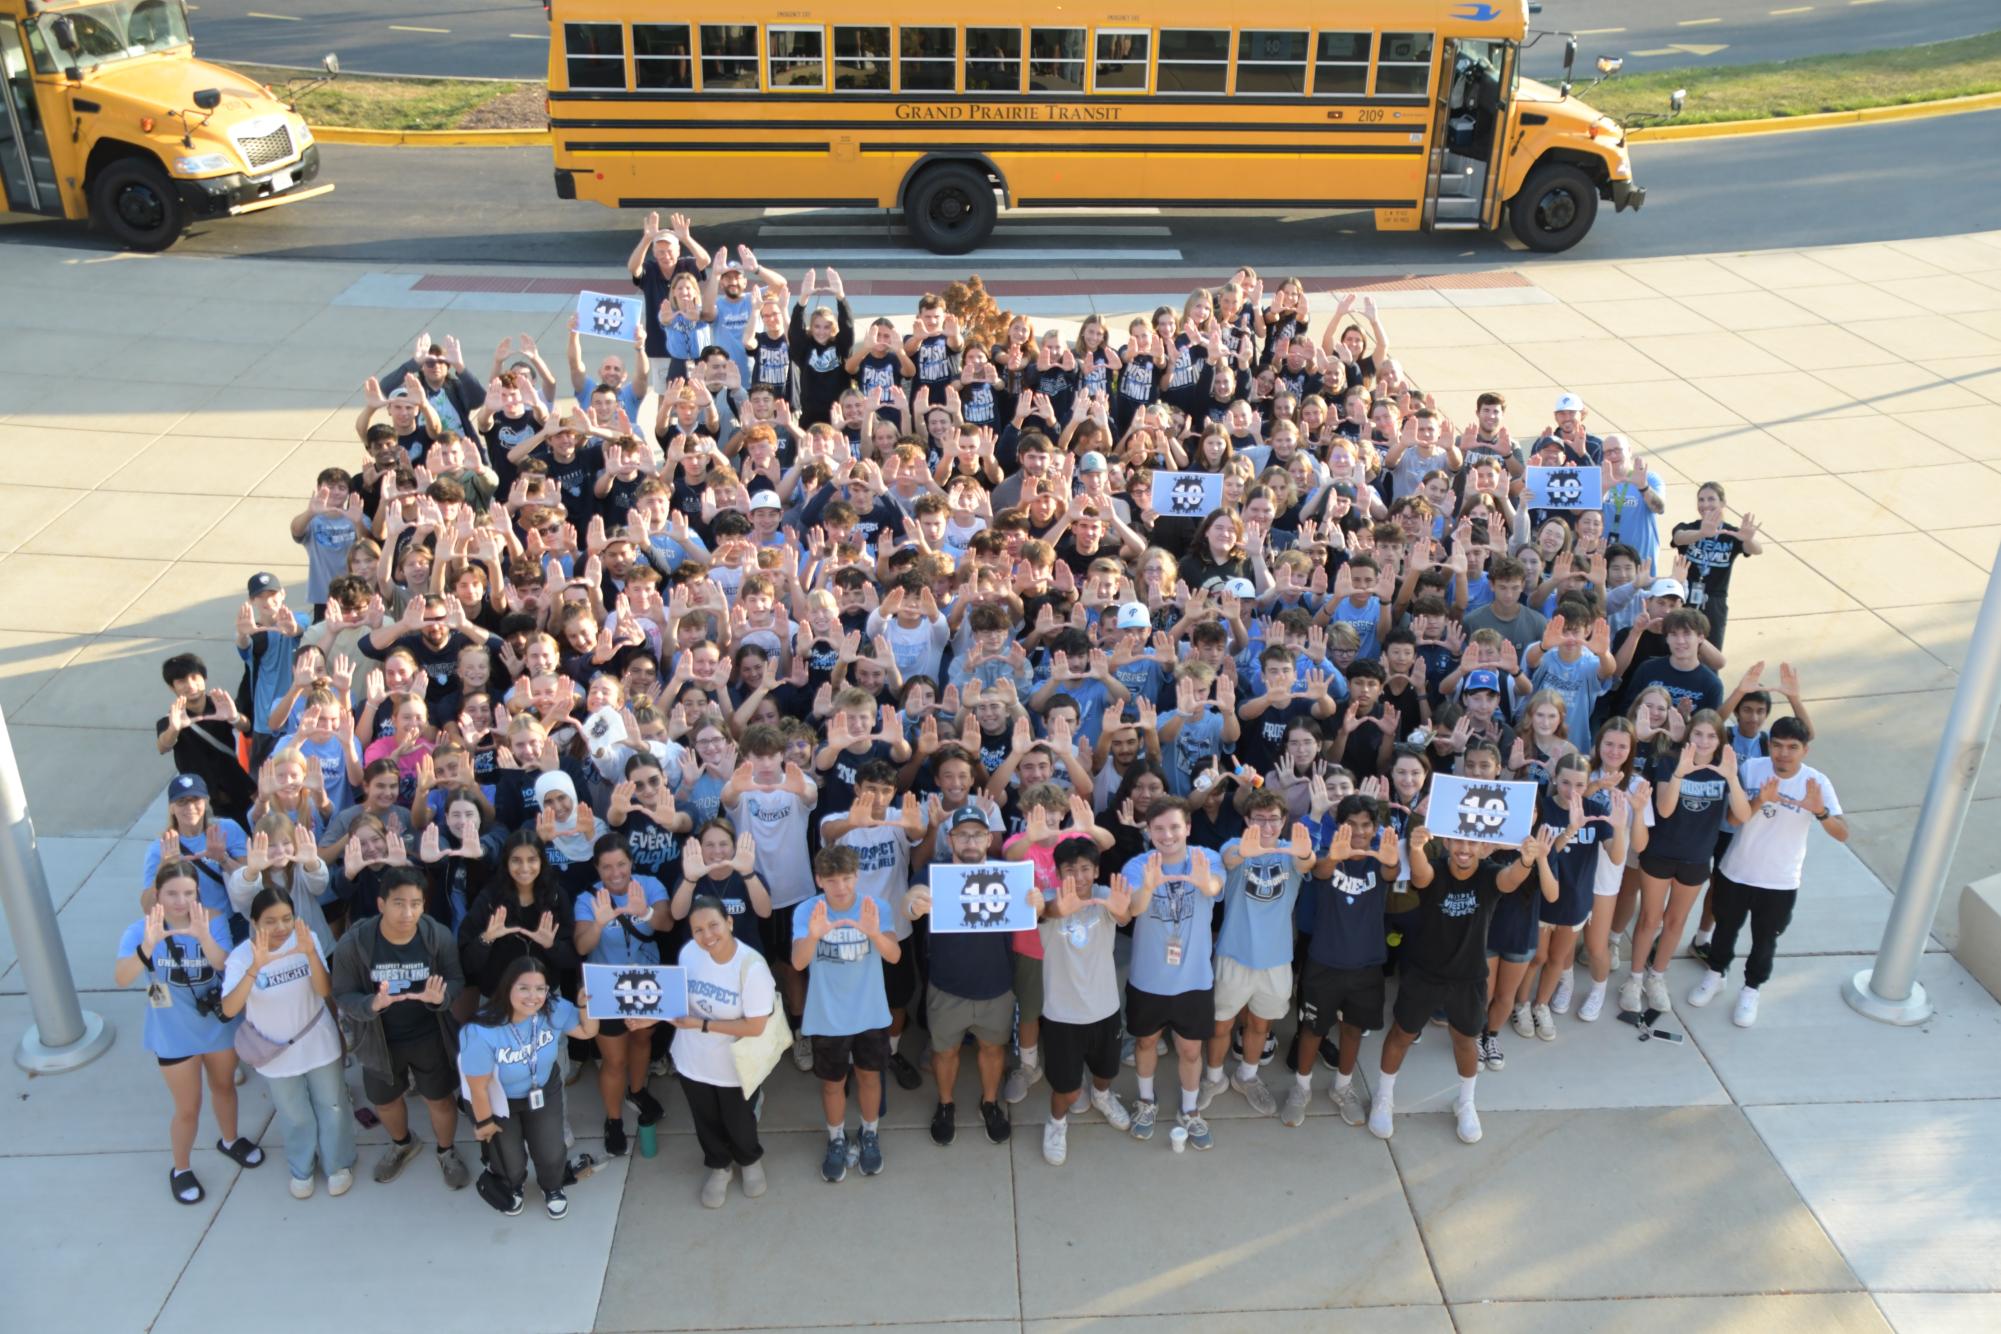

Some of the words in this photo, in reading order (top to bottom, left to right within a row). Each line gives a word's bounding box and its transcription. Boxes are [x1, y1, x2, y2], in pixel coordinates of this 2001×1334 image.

[895, 104, 962, 119] GRAND
[969, 104, 1039, 120] PRAIRIE
[1045, 105, 1121, 120] TRANSIT
[1359, 109, 1384, 122] 2109
[628, 832, 674, 850] EVERY
[371, 967, 430, 982] WRESTLING
